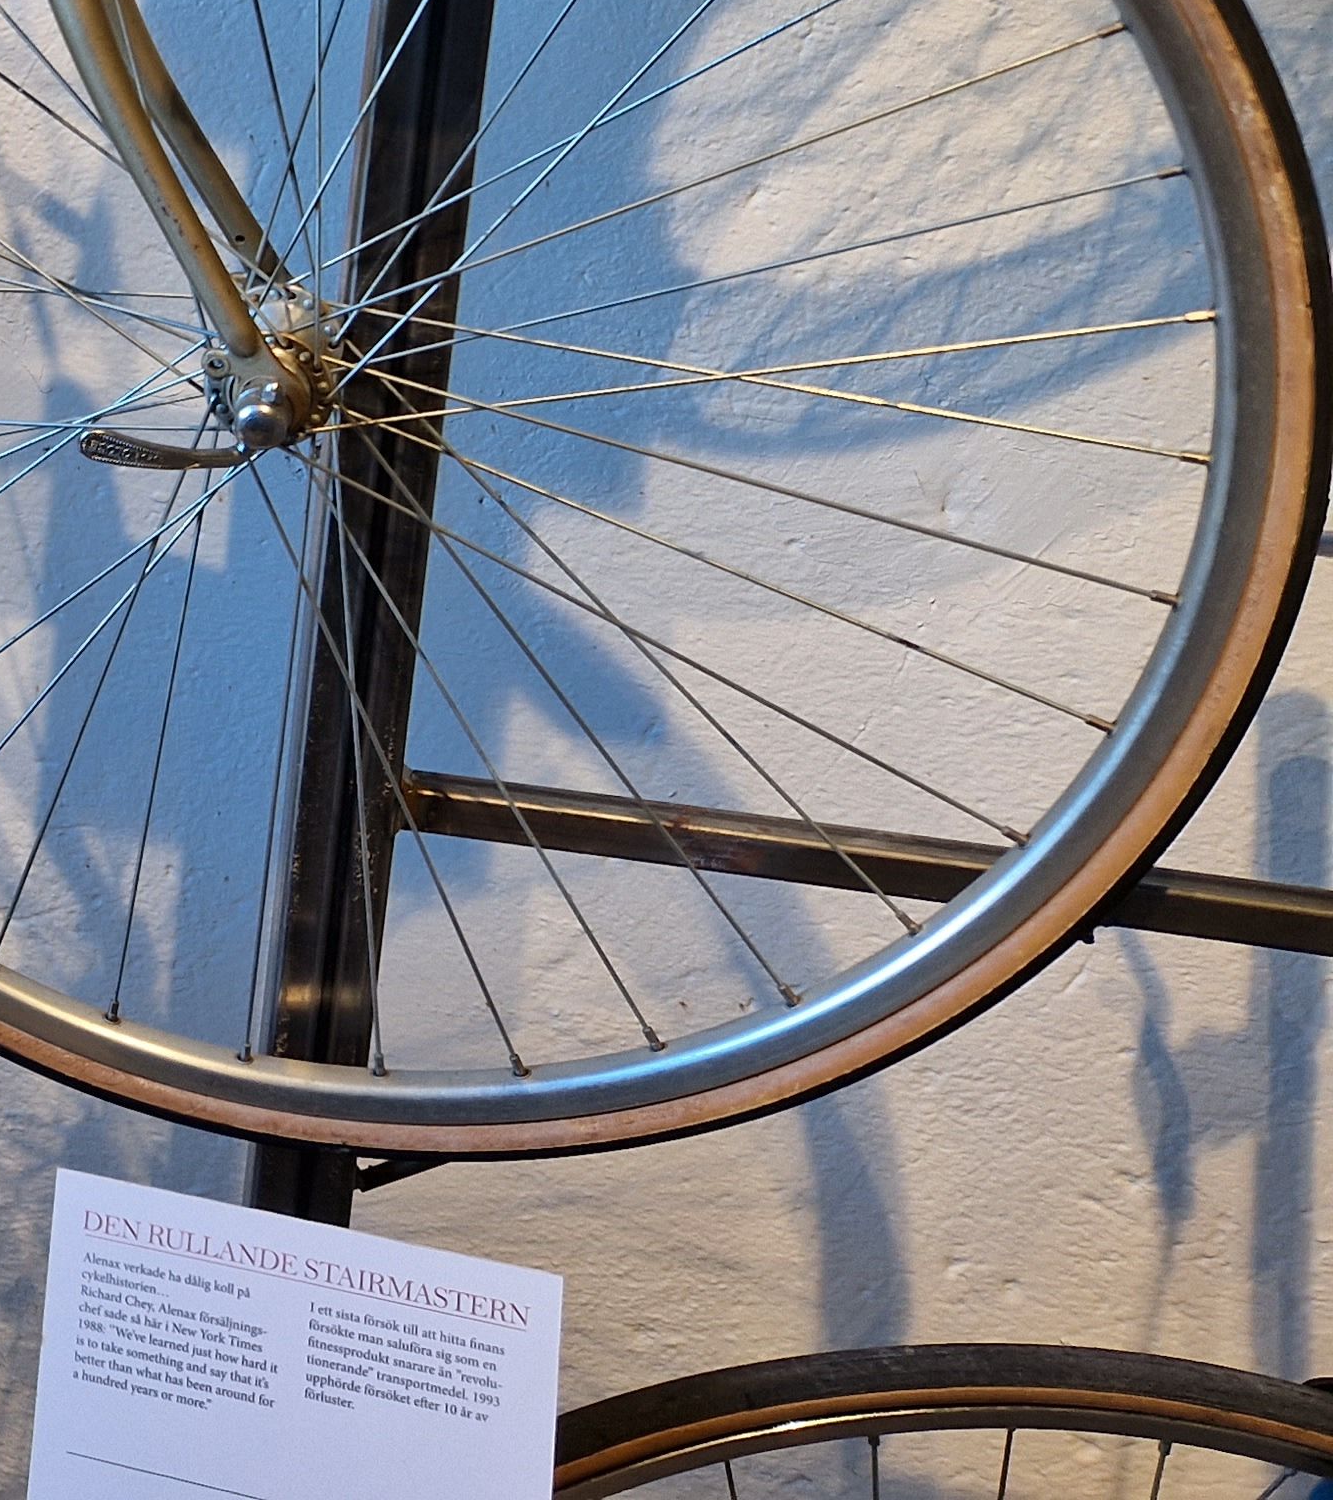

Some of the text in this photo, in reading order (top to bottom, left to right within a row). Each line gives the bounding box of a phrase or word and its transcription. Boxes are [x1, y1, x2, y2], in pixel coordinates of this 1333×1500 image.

[84, 1209, 532, 1327] DEN RULLANDE STAIRMASTERN
[309, 1318, 496, 1371] försökte man saluföra sig som en
[310, 1301, 504, 1355] I ett sista försök till att hitta finans
[308, 1336, 390, 1365] fitnessprodukt
[393, 1358, 435, 1375] snarare
[438, 1366, 452, 1379] än
[305, 1387, 354, 1409] förluster.
[306, 1373, 489, 1422] upphörde försöket efter 10 år av
[377, 1370, 468, 1400] transportmedel.
[474, 1392, 500, 1407] 1993
